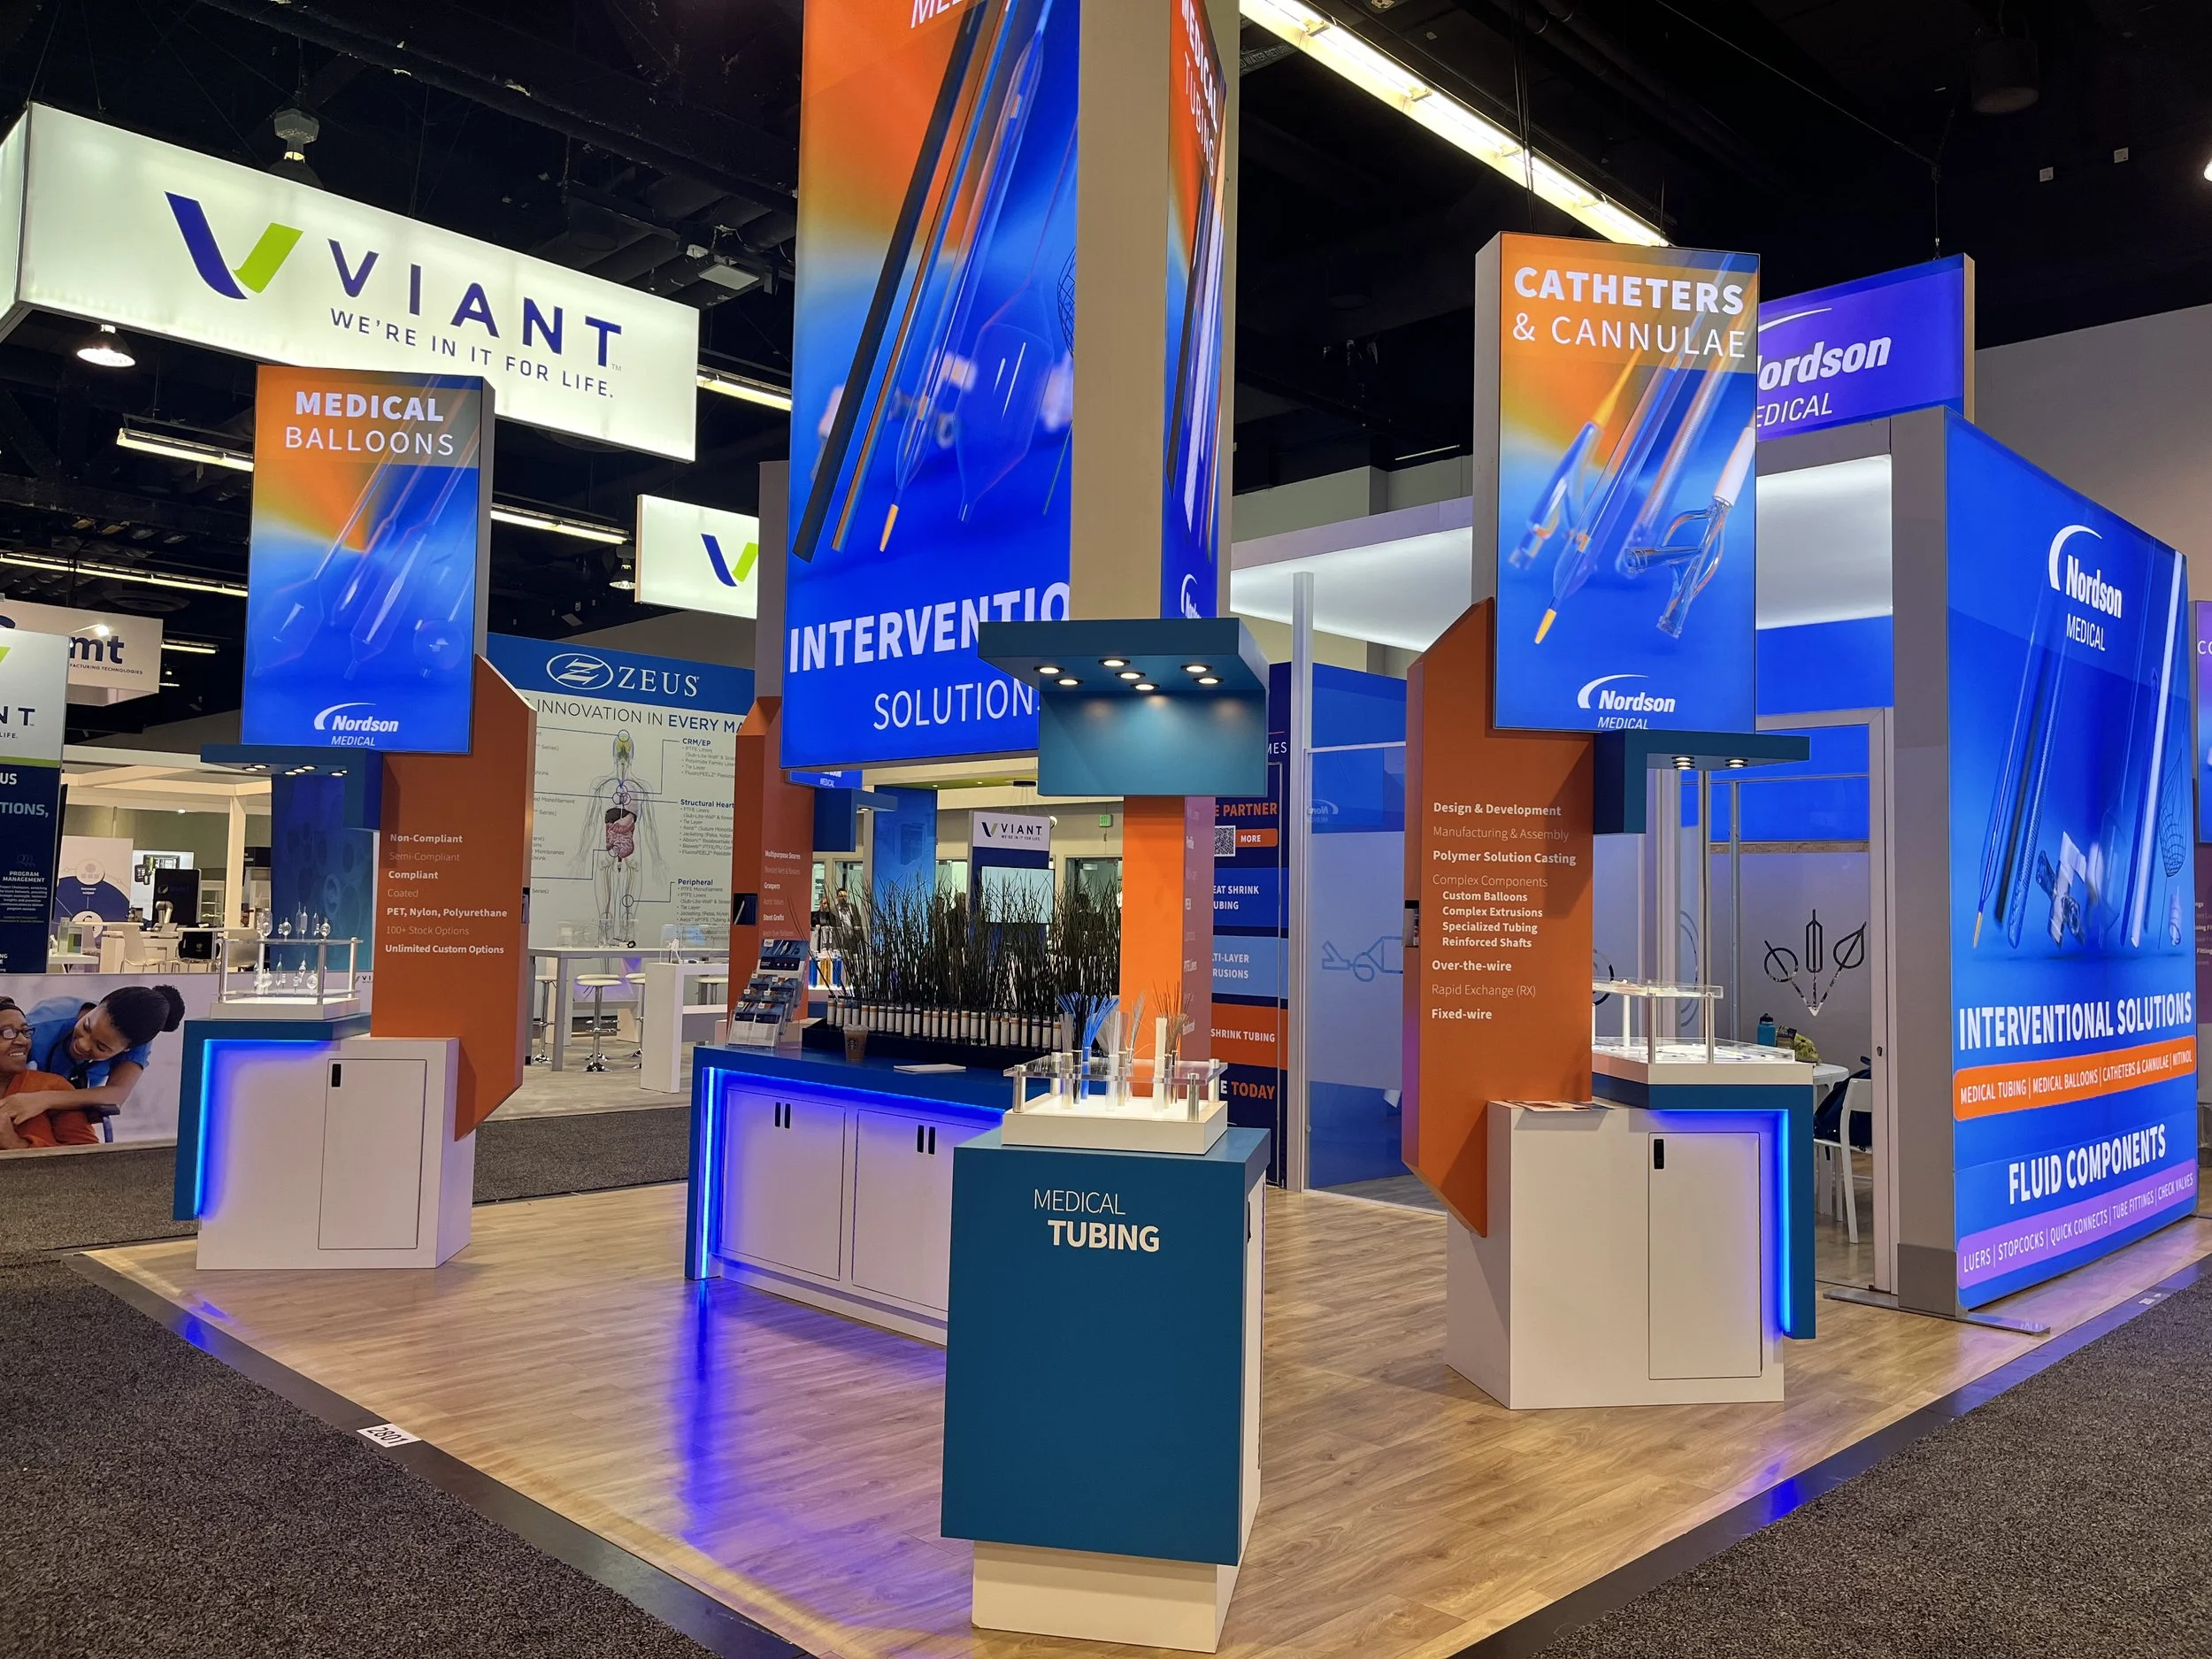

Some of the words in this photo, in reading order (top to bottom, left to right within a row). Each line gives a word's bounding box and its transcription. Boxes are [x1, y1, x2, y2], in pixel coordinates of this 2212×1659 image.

[1181, 0, 1217, 133] MEDICAL
[1185, 50, 1214, 177] TUBING
[1514, 266, 1744, 315] CATHETERS
[328, 239, 622, 367] VIANT
[1512, 312, 1536, 342] &
[1550, 314, 1746, 358] CANNULAE
[330, 307, 416, 347] WE'RE
[432, 335, 456, 357] IN
[471, 346, 492, 365] IT
[506, 356, 549, 381] FOR
[562, 370, 614, 398] LIFE.
[1758, 335, 1892, 392] ordson
[296, 390, 445, 423] MEDICAL
[284, 425, 455, 457] BALLOONS
[2065, 554, 2123, 619] Nordson
[2066, 613, 2106, 652] MEDICAL
[102, 666, 143, 675] TECHNOLOGIES
[618, 665, 700, 698] ZEUS
[872, 678, 1041, 731] SOLUTION
[1598, 690, 1676, 713] Nordson
[536, 699, 641, 724] INNOVATION
[648, 711, 664, 726] IN
[668, 714, 719, 732] EVERY
[1597, 717, 1649, 730] MEDICAL
[332, 715, 399, 733] Nordson
[330, 735, 376, 747] MEDICAL
[682, 737, 711, 747] CRM/EP
[680, 798, 715, 807] Structural
[1223, 803, 1278, 817] PARTNER
[1433, 802, 1472, 815] Design
[1474, 803, 1483, 814] &
[1486, 803, 1562, 817] Development
[1001, 823, 1042, 835] VIANT
[1433, 826, 1508, 841] Manufacturing
[1509, 829, 1518, 839] &
[1519, 829, 1569, 842] Assembly
[390, 833, 463, 845] Non-Compliant
[1240, 834, 1262, 843] MORE
[389, 851, 460, 863] Semi-Compliant
[1432, 849, 1481, 864] Polymer
[1483, 850, 1532, 864] Solution
[1534, 852, 1577, 866] Casting
[388, 870, 439, 881] Compliant
[1432, 874, 1479, 887] Complex
[1481, 875, 1548, 888] Components
[388, 887, 419, 898] Coated
[1227, 886, 1260, 895] SHRINK
[1442, 890, 1481, 901] Custom
[1483, 891, 1528, 902] Balloons
[387, 907, 408, 918] PET,
[410, 908, 441, 918] Nylon,
[443, 908, 508, 919] Polyurethane
[1442, 906, 1487, 918] Complex
[1489, 907, 1543, 918] Extrusions
[387, 926, 406, 935] 100+
[408, 926, 433, 935] Stock
[434, 926, 470, 937] Options
[1442, 921, 1500, 933] Specialized
[1502, 922, 1538, 934] Tubing
[385, 944, 430, 955] Unlimited
[432, 944, 466, 955] Custom
[469, 945, 504, 956] Options
[1442, 936, 1497, 948] Reinforced
[1500, 937, 1532, 949] Shafts
[1212, 953, 1249, 964] TI-LAYER
[1432, 959, 1512, 972] Over-the-wire
[1432, 983, 1462, 997] Rapid
[1464, 984, 1514, 999] Exchange
[1517, 985, 1536, 998] (RX)
[1432, 1008, 1493, 1020] Fixed-wire
[1959, 1001, 2114, 1050] INTERVENTIONAL
[2116, 990, 2193, 1036] SOLUTIONS
[1210, 1028, 1241, 1040] SHRINK
[1243, 1031, 1276, 1042] TUBING
[1960, 1085, 1996, 1105] MEDICAL
[1998, 1079, 2026, 1099] TUBING
[2032, 1074, 2062, 1094] MEDICAL
[2063, 1068, 2099, 1089] BALLOONS
[2102, 1061, 2136, 1083] CATHETERS
[2141, 1054, 2170, 1074] CANNULAE
[2172, 1048, 2193, 1066] NITINOL
[1231, 1081, 1276, 1100] TODAY
[2008, 1155, 2062, 1205] FLUID
[2066, 1123, 2167, 1189] COMPONENTS
[1033, 1188, 1126, 1216] MEDICAL
[1963, 1248, 1991, 1273] LUERS
[1998, 1233, 2044, 1261] STOPCOCKS
[2050, 1222, 2073, 1245] QUICK
[2073, 1209, 2108, 1236] CONNECTS
[2112, 1200, 2128, 1221] TUBE
[2129, 1192, 2154, 1215] FITTINGS
[2157, 1181, 2175, 1201] CHECK
[2175, 1172, 2194, 1194] VALVES
[1048, 1219, 1160, 1253] TUBING
[366, 1426, 409, 1444] 2801
